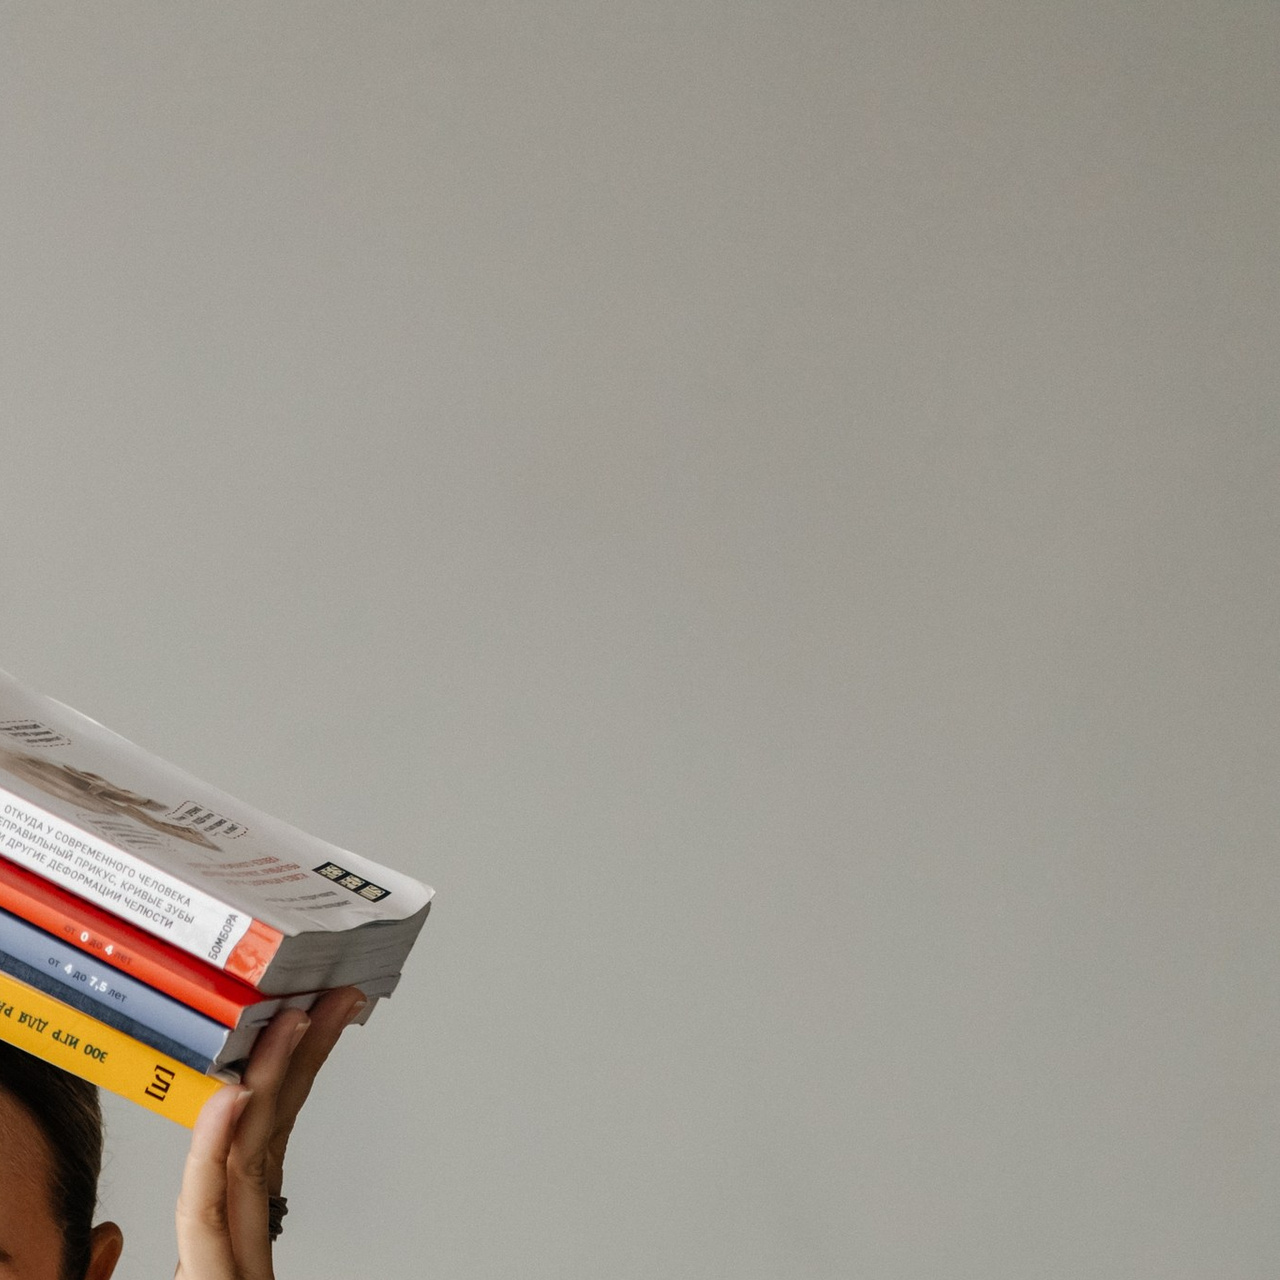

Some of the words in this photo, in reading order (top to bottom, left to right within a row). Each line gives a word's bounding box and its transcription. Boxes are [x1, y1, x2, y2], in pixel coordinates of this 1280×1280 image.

[4, 804, 44, 831] ОТКУДА
[46, 823, 54, 835] У
[54, 831, 135, 878] СОВРЕМЕННОГО
[138, 872, 192, 907] ЧЕЛОВЕКА
[5, 836, 45, 864] ДРУГИЕ
[46, 859, 122, 902] ДЕФОРМАЦИИ
[123, 896, 174, 929] ЧЕЛЮСТИ
[74, 853, 117, 887] ПРИКУС,
[120, 879, 164, 909] КРИВЫЕ
[164, 901, 195, 925] ЗУБЫ
[80, 931, 89, 942] 0
[104, 944, 114, 956] 4
[207, 913, 239, 961] БОМБОРА
[47, 956, 61, 968] от
[63, 964, 73, 975] 4
[72, 970, 87, 983] до
[89, 976, 108, 993] 7,5
[107, 989, 128, 1003] лет
[17, 1011, 49, 1033] ДЛЯ
[52, 1028, 80, 1050] ИГР
[83, 1043, 109, 1065] 300
